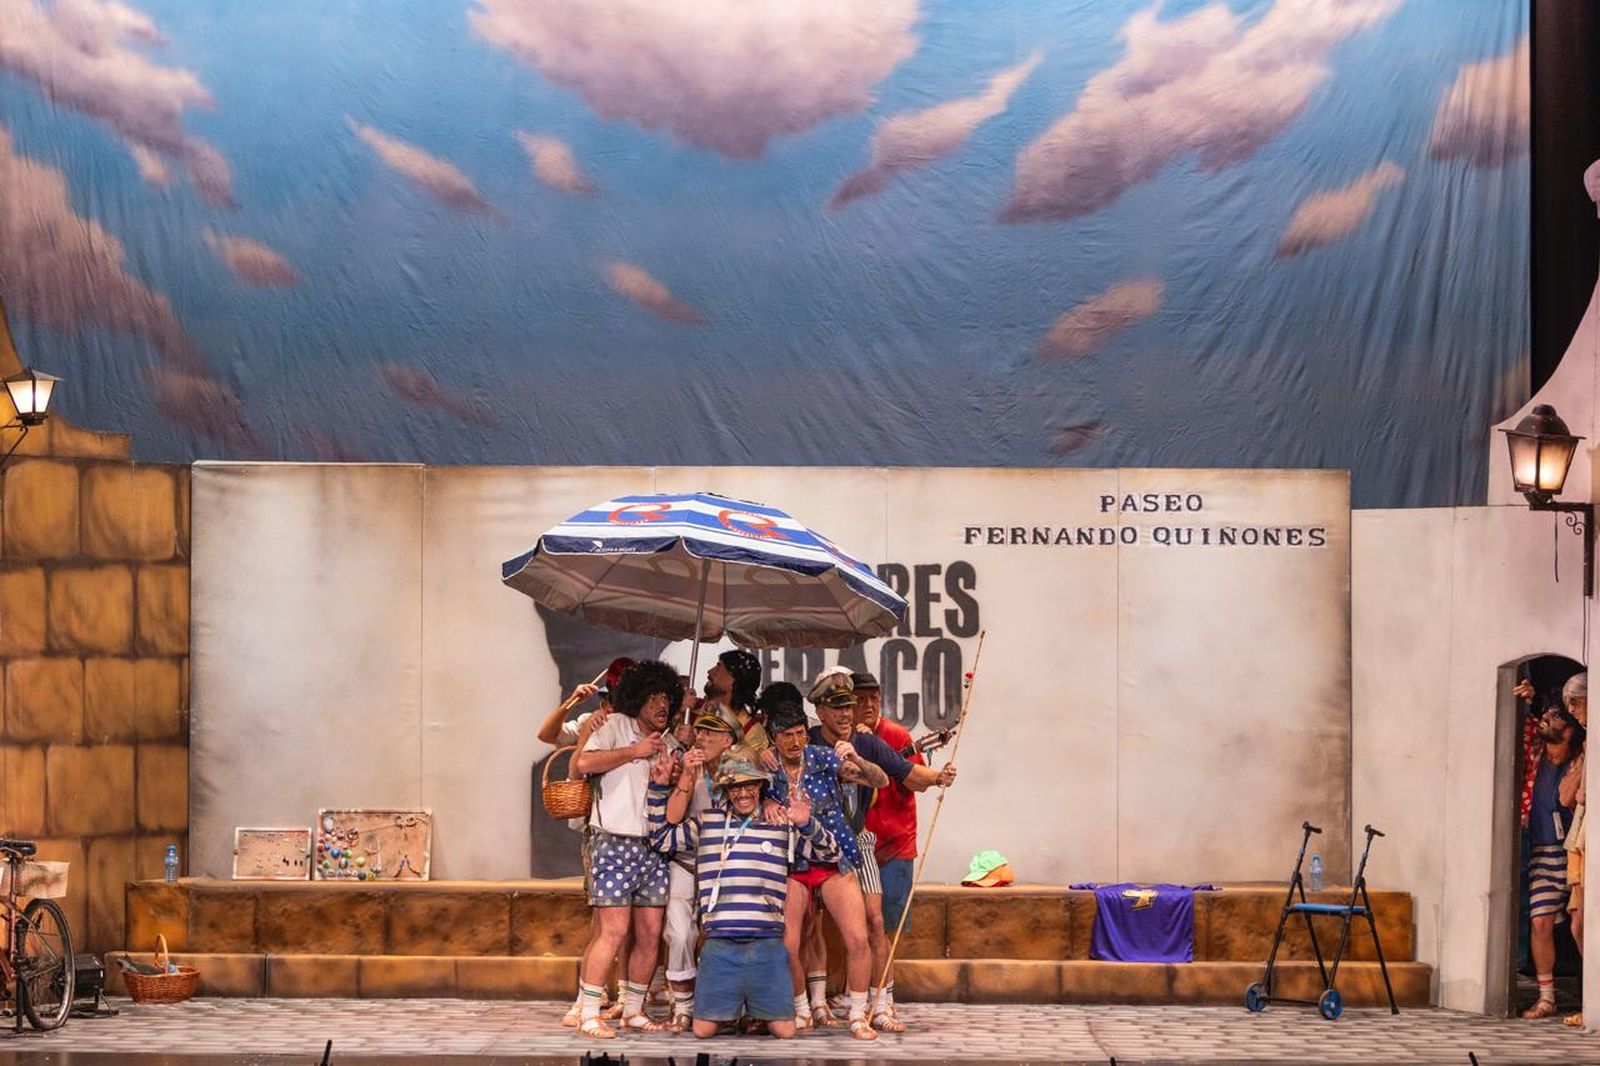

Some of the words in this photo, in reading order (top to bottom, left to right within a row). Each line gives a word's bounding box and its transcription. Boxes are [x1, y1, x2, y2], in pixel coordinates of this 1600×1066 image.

[1100, 493, 1203, 513] PASEO
[964, 527, 1138, 546] FERNANDO
[877, 560, 980, 638] RES
